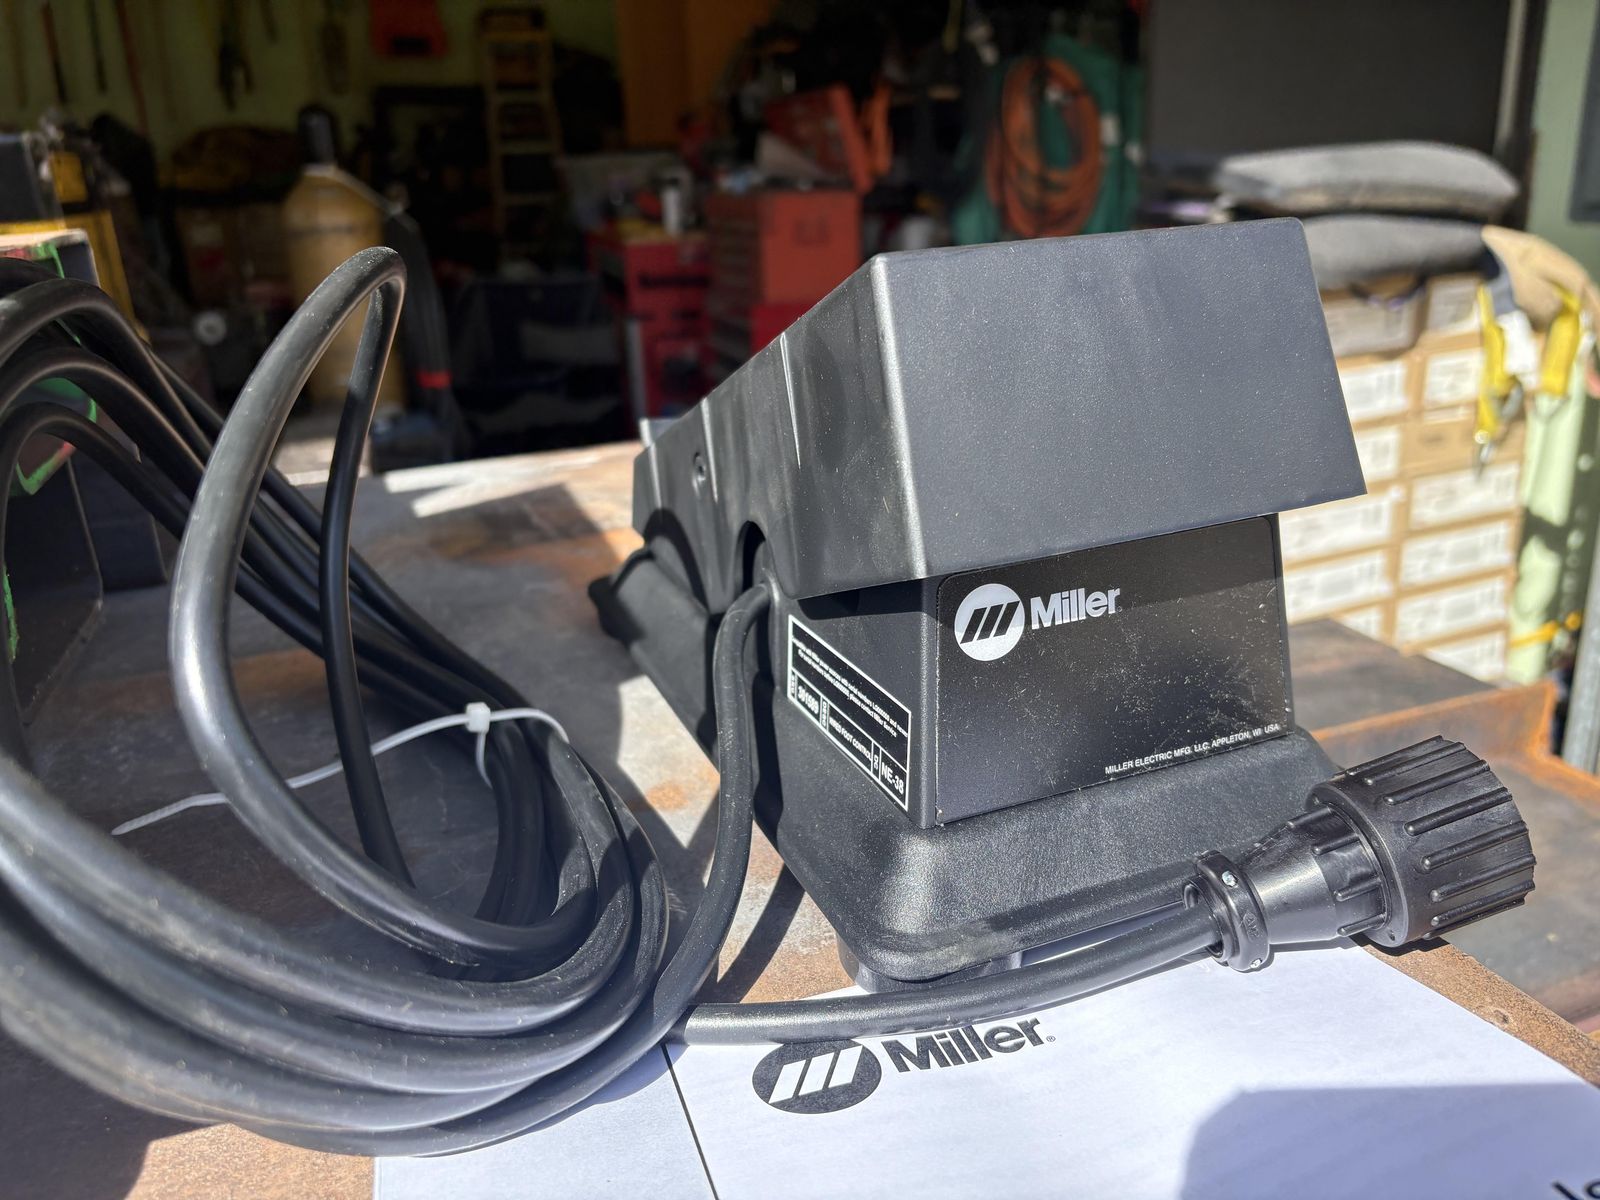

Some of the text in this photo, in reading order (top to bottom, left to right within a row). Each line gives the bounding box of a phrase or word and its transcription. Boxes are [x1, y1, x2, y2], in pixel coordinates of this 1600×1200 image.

[1031, 588, 1120, 630] Miller
[1105, 761, 1133, 774] MILLER
[1135, 751, 1173, 767] ELECTRIC
[1174, 747, 1192, 757] MFG.
[881, 762, 903, 794] NE-38
